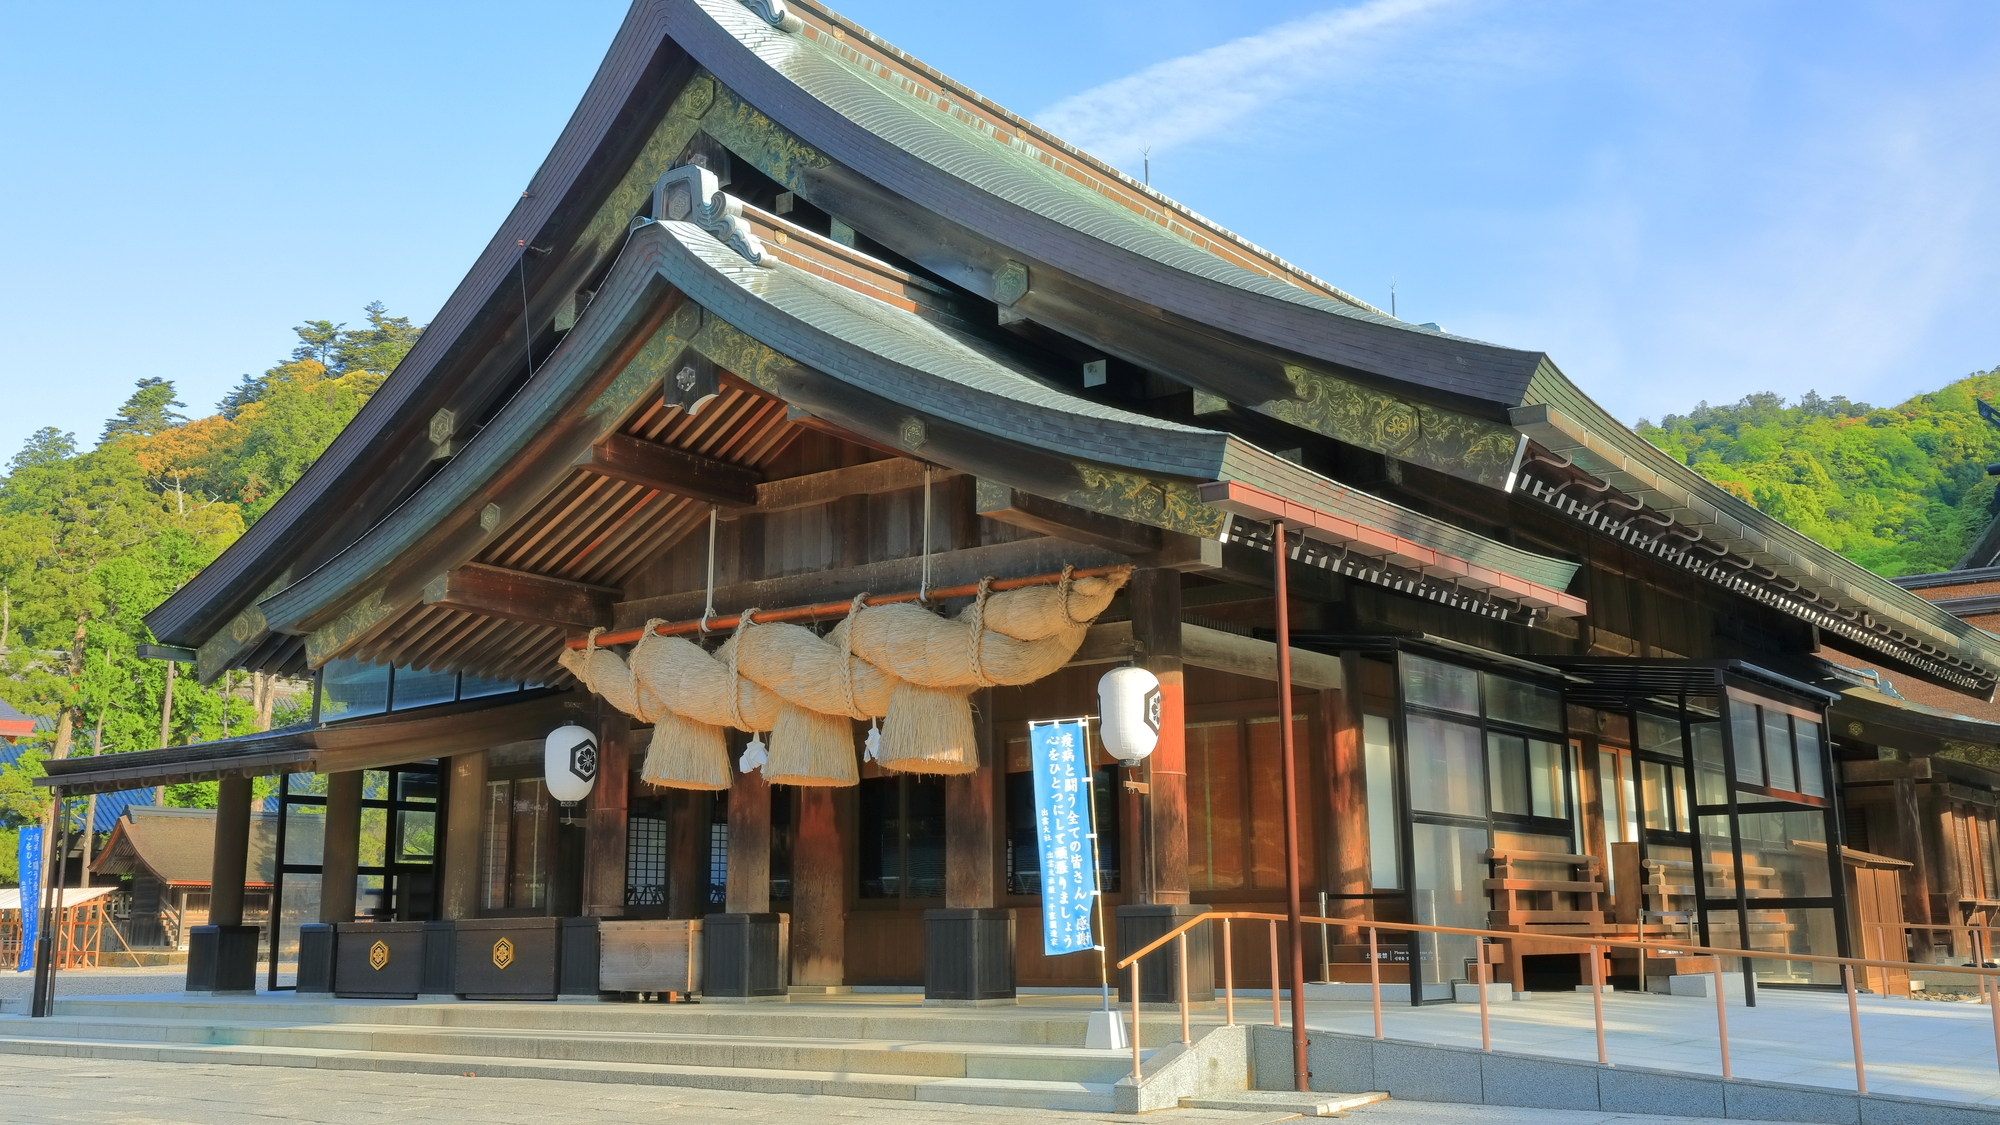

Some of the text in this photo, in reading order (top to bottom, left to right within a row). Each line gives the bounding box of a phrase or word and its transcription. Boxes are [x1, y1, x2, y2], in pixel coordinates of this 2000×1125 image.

[1046, 735, 1073, 949] 心をひとつにして頑張りましょう
[1060, 732, 1091, 946] 疫病と闘う全ての皆さんへ感謝
